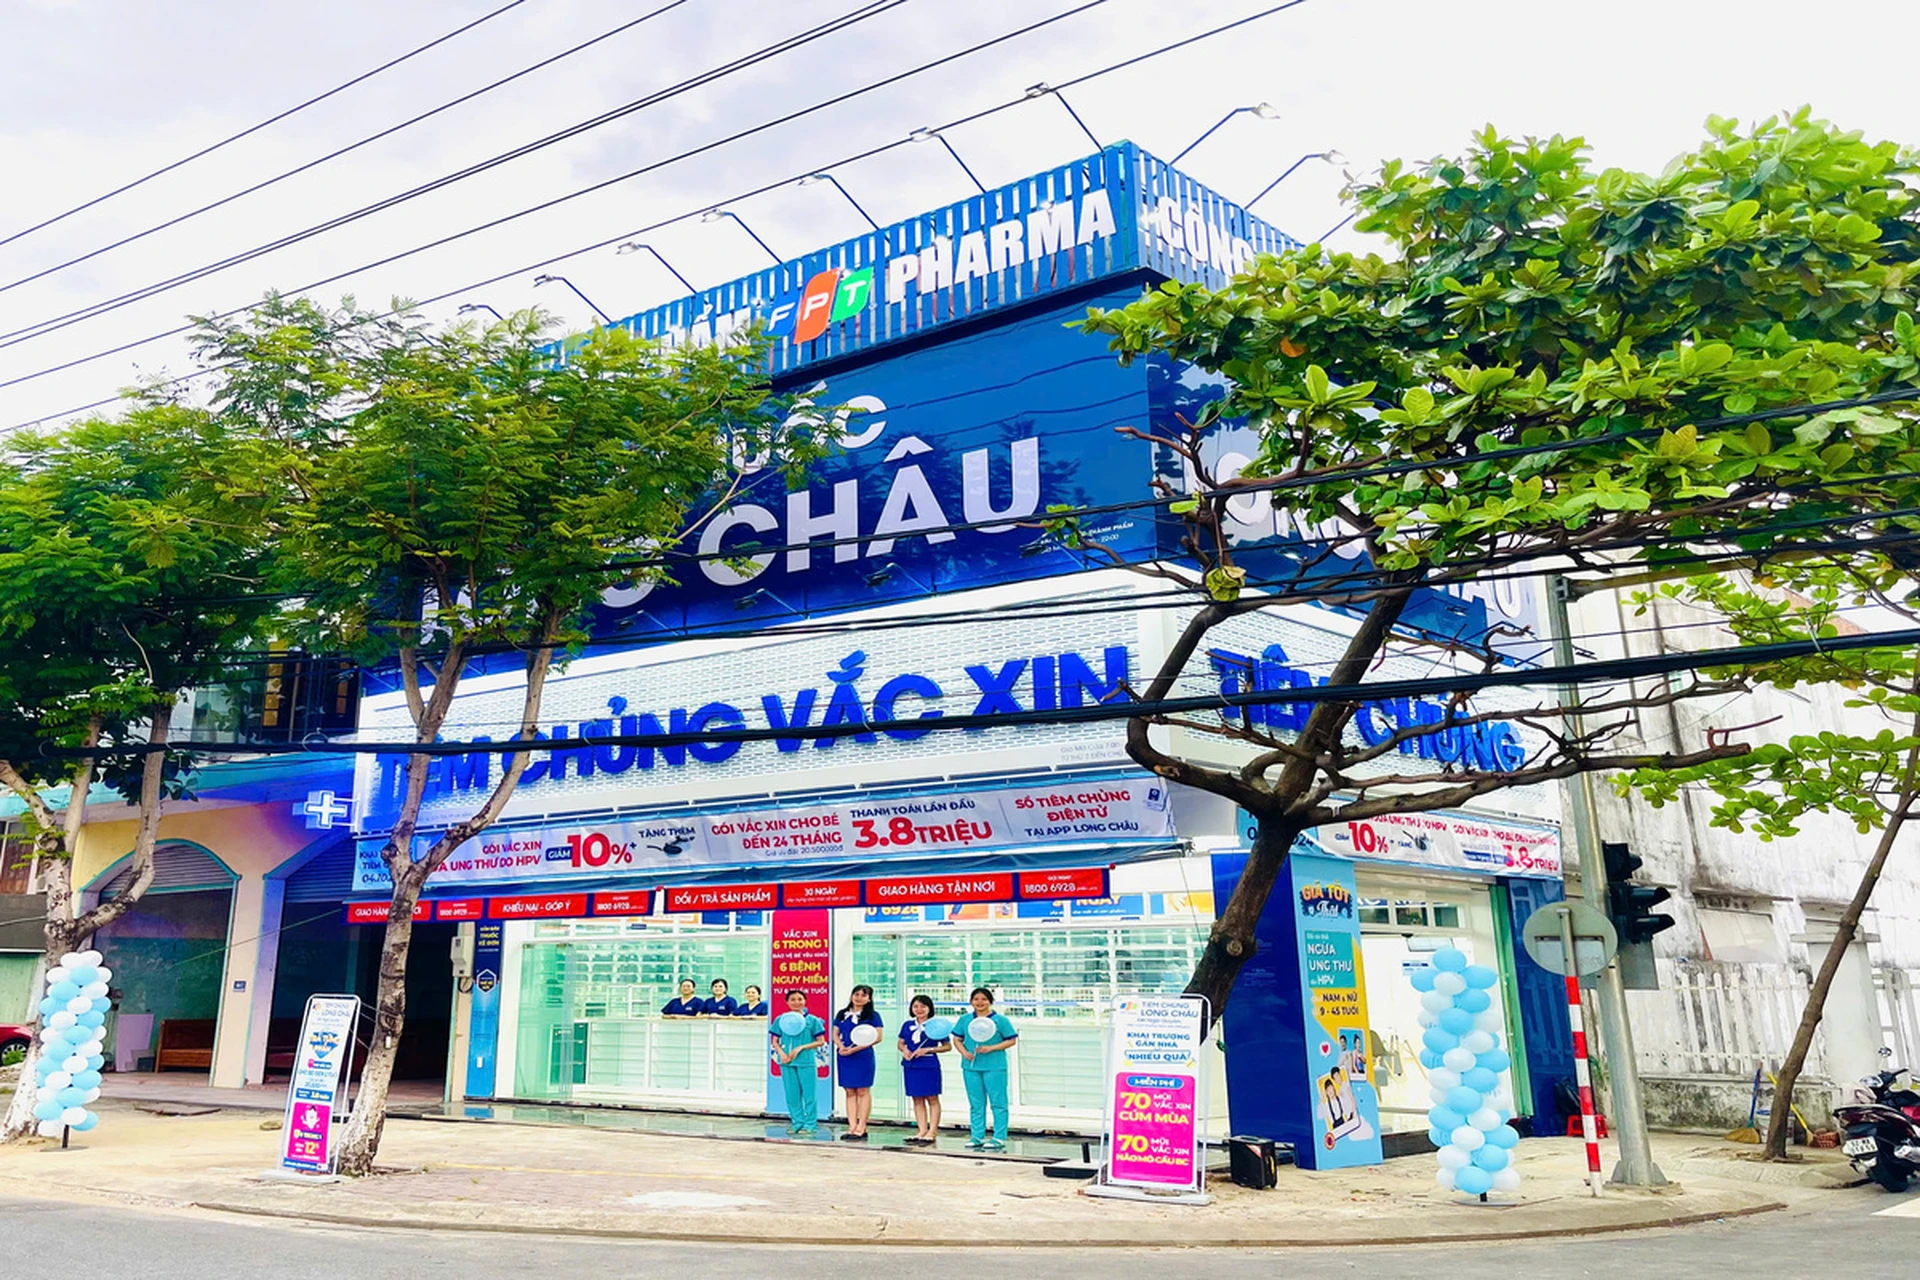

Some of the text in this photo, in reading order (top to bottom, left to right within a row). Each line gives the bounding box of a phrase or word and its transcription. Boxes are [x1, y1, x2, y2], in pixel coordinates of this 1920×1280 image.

[766, 188, 1117, 336] FPT PHARMA
[699, 436, 1038, 586] CHÂU
[502, 696, 746, 785] CHỦNG
[762, 650, 944, 753] VẮC
[964, 646, 1130, 732] XIN
[1036, 790, 1075, 807] TIÊM
[850, 807, 891, 818] THANH
[891, 804, 922, 815] TOÁN
[1046, 808, 1085, 822] ĐIỆN
[711, 812, 840, 836] GÓI VẮC XIN CHO BÉ
[1046, 825, 1071, 836] APP
[1074, 823, 1106, 833] LONG
[1108, 820, 1139, 831] CHÂU
[852, 816, 993, 848] 3.8 TRIỆU
[1348, 822, 1388, 853] 10%
[523, 840, 542, 850] XIN
[742, 831, 842, 849] ĐẾN 24 THÁNG
[567, 832, 633, 868] 10%
[516, 855, 541, 867] HPV
[742, 887, 771, 902] PHẨM
[878, 880, 995, 898] GIAO HÀNG TẬN NƠI
[1025, 883, 1048, 893] 1800
[1049, 882, 1076, 892] 6928
[1302, 879, 1350, 904] GIÁ TỐT
[783, 927, 818, 939] VẮC XIN
[773, 938, 829, 950] 6 TRONG 1
[780, 960, 821, 973] 6 BỆNH
[1308, 960, 1353, 972] UNG THƯ
[772, 972, 829, 985] NGUY HIỂM
[1317, 976, 1335, 985] HPV
[1322, 992, 1340, 1002] NAM
[1140, 1009, 1169, 1017] LONG
[1320, 1006, 1325, 1016] 9
[1331, 1006, 1340, 1016] 45
[1120, 1092, 1151, 1109] 70
[1153, 1100, 1173, 1109] VẮC
[1119, 1109, 1189, 1124] CÚM MÙA
[1117, 1134, 1149, 1152] 70
[1151, 1144, 1171, 1154] VẮC
